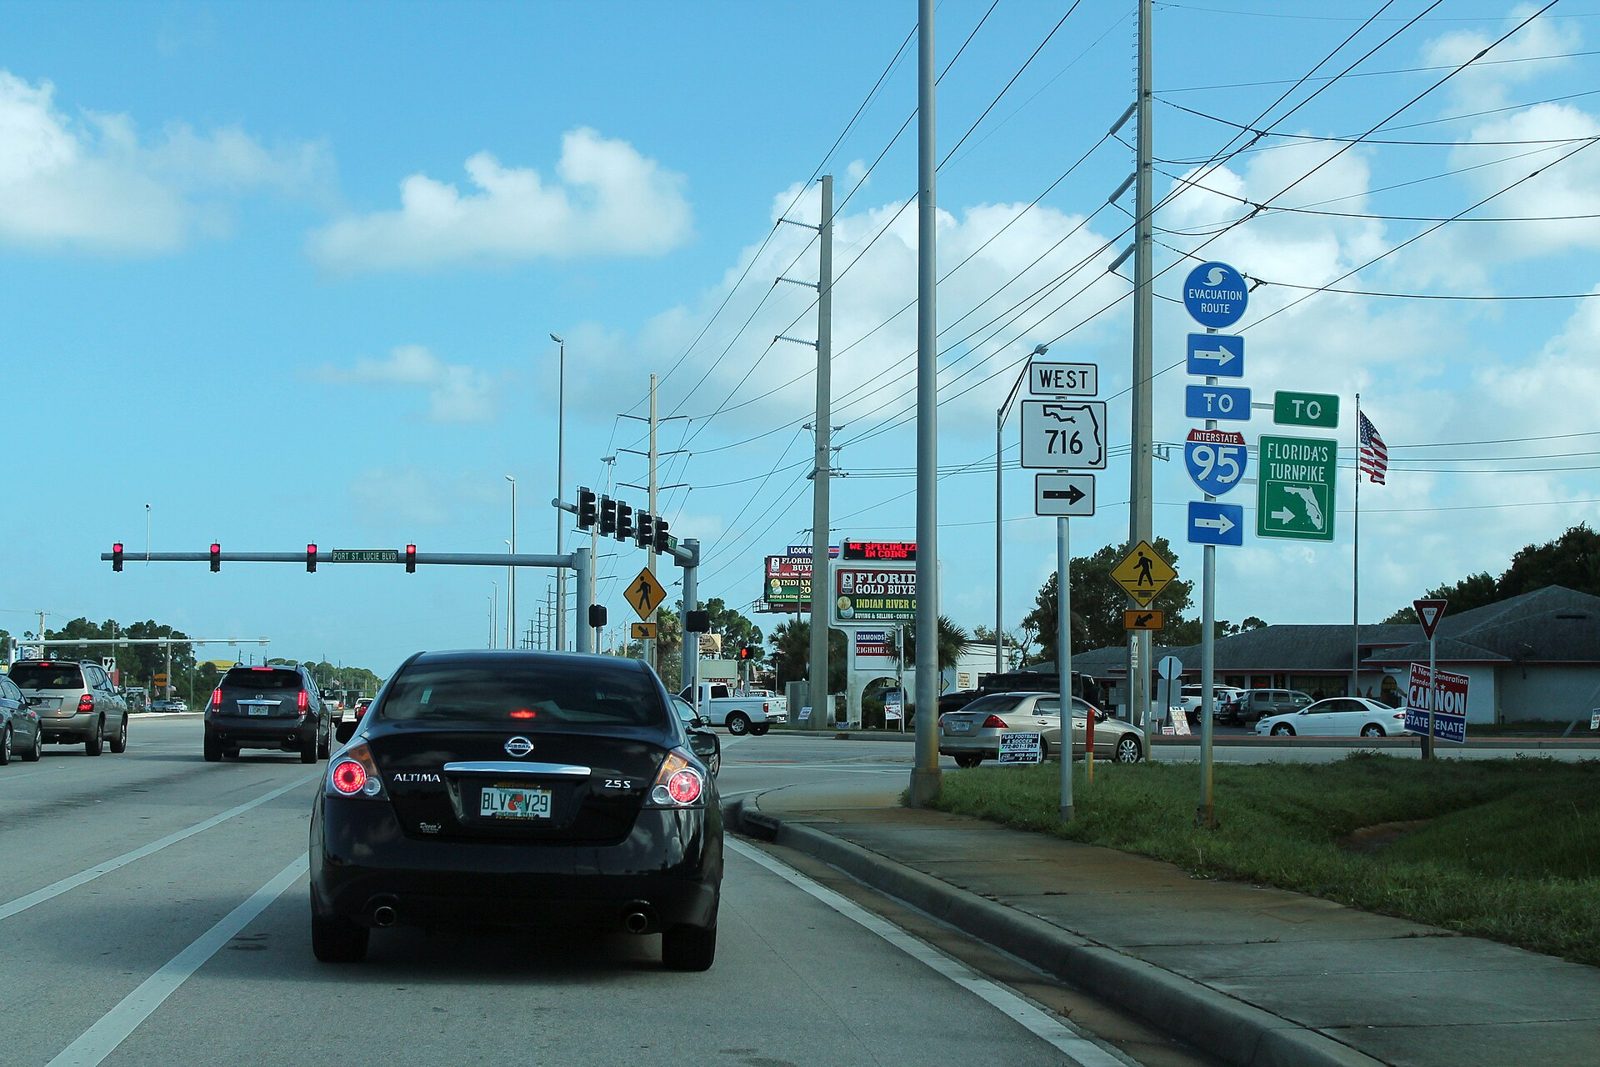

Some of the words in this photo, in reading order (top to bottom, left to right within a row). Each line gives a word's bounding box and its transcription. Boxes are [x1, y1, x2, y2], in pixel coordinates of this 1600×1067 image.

[1188, 288, 1243, 301] EVACUATION
[1201, 302, 1230, 314] ROUTE
[1039, 369, 1088, 389] WEST
[1203, 393, 1234, 413] TO
[1291, 399, 1322, 420] TO
[1045, 429, 1083, 454] 716
[1194, 432, 1239, 443] INTERSTATE
[1267, 443, 1329, 462] FLORIDA'S
[1192, 445, 1240, 484] 95
[1269, 463, 1325, 482] TURNPIKE
[864, 543, 916, 551] SPECIALIZ
[332, 552, 350, 560] PORT
[351, 552, 361, 560] ST.
[362, 552, 380, 560] LUCIE
[381, 552, 397, 560] BLVD
[864, 550, 876, 558] IN
[878, 550, 908, 558] COINS
[855, 572, 916, 584] FLORID
[855, 584, 885, 594] GOLD
[887, 584, 916, 594] BUYE
[856, 598, 883, 609] INDIAN
[885, 599, 910, 609] RIVER
[1406, 714, 1429, 728] STATE
[393, 773, 441, 782] ALTIMA
[623, 780, 631, 789] S
